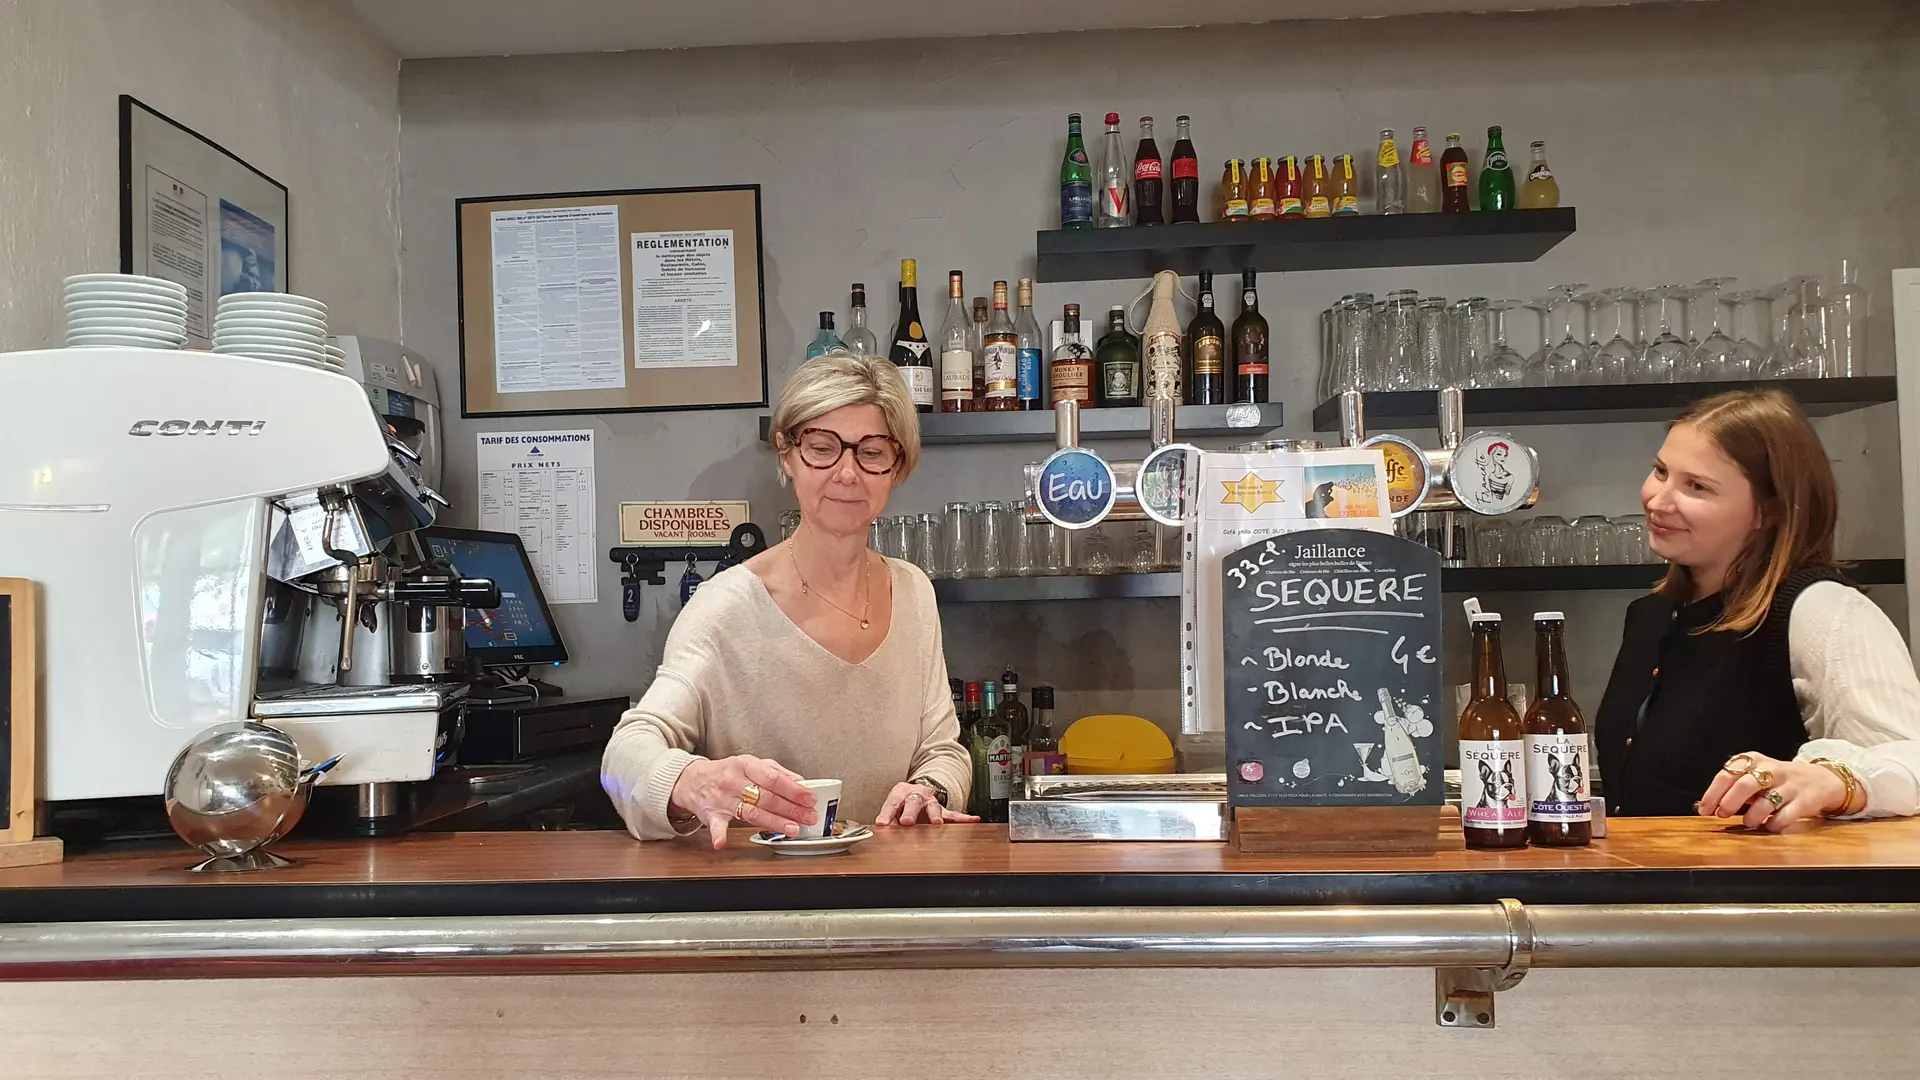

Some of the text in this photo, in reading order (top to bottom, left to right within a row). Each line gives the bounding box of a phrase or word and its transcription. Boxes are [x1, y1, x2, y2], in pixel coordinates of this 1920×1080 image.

[636, 238, 730, 249] REGLEMENTATION
[128, 419, 266, 437] CONTI
[481, 434, 591, 445] TARIF DES CONSOMMATIONS
[1386, 458, 1405, 484] ffe
[1473, 447, 1492, 504] Francette
[1048, 472, 1103, 502] Eau
[1389, 494, 1409, 503] NDE
[643, 507, 724, 519] CHAMBRES
[639, 519, 731, 531] DISPONIBLES
[1294, 543, 1366, 559] Jaillance
[627, 589, 634, 603] 2
[1263, 646, 1350, 672] Blonde
[1263, 679, 1363, 705] Blanche
[1267, 711, 1349, 739] IPA
[1556, 737, 1570, 745] LA
[1533, 743, 1588, 754] SÉQUÈRE
[989, 754, 1012, 762] MARTI
[1532, 802, 1555, 811] CÔTE
[1555, 803, 1583, 811] OUEST
